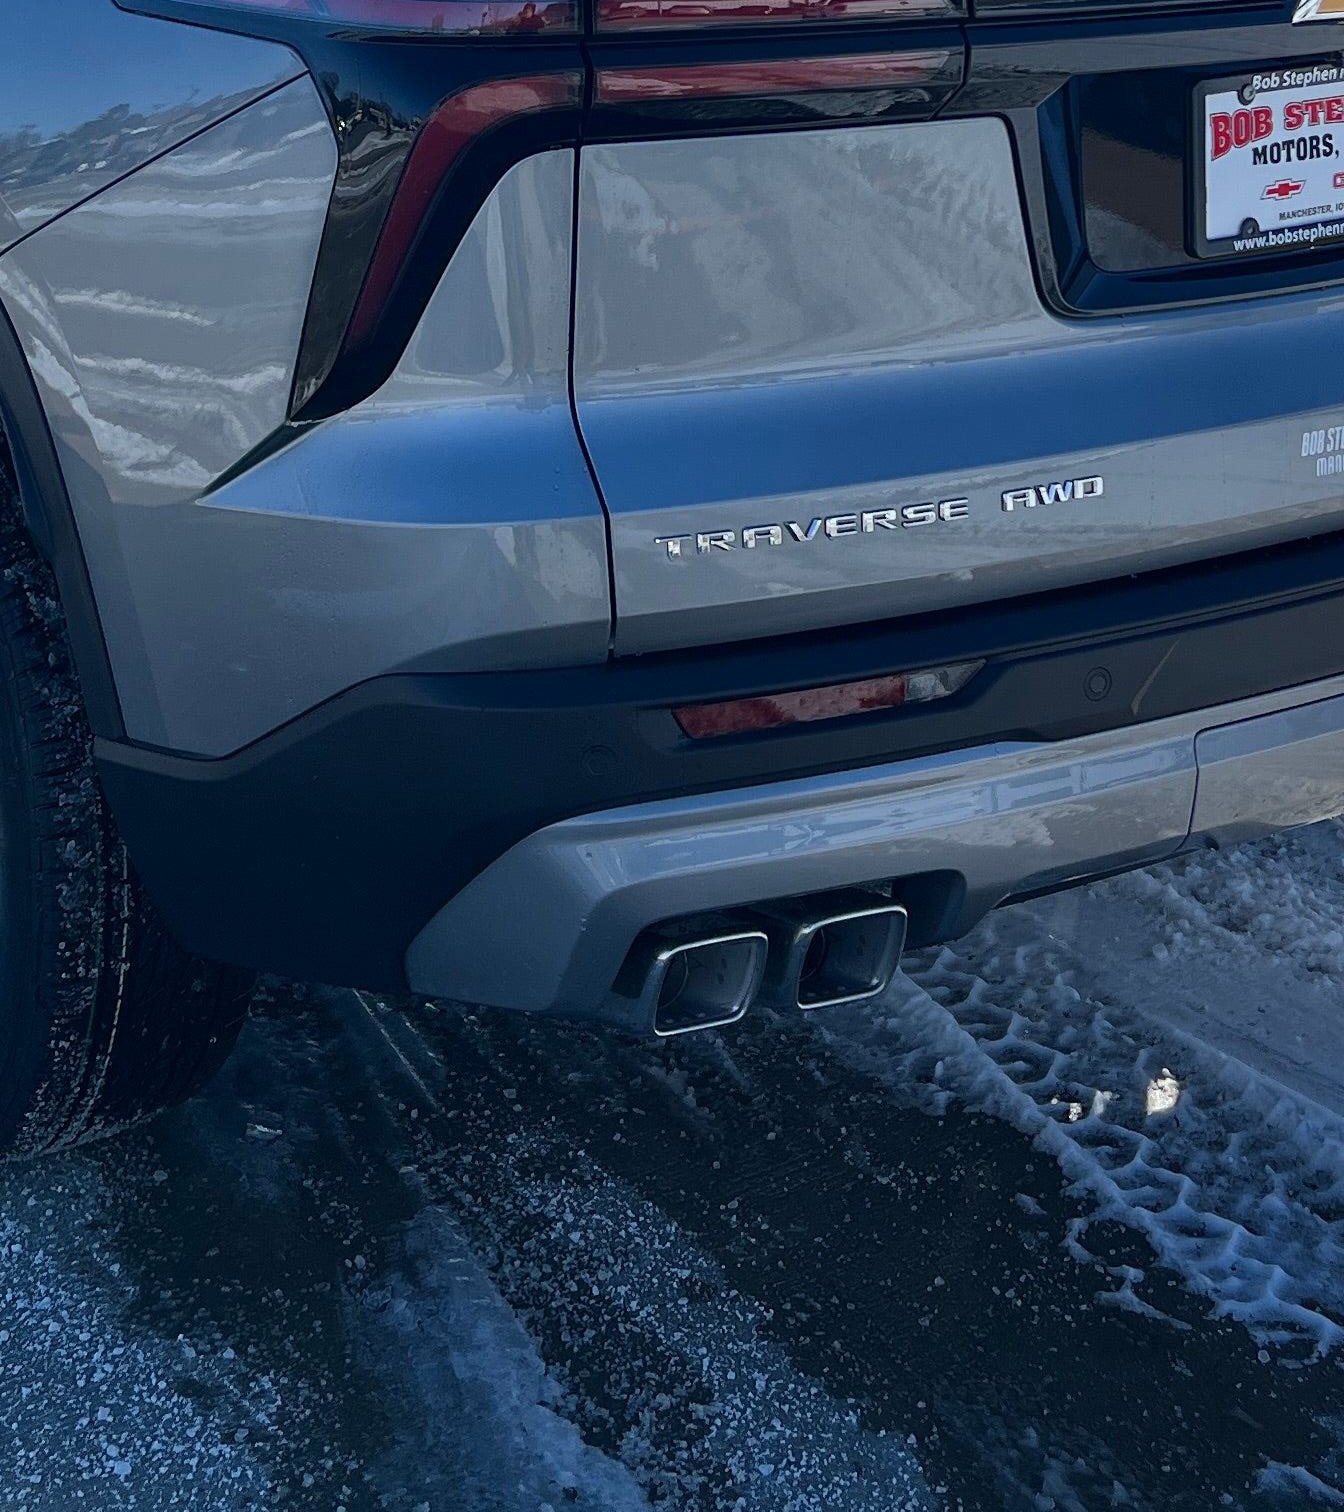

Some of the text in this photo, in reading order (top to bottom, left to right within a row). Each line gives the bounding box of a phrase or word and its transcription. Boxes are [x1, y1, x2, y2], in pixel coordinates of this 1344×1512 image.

[1252, 74, 1280, 90] Bob
[1282, 66, 1337, 88] Stephen
[1210, 106, 1273, 161] BOB
[1252, 133, 1340, 165] MOTORS,
[1279, 204, 1333, 221] MANCHESTER,
[1301, 429, 1327, 457] BOB
[654, 475, 1104, 561] TRAVERSE AWD
